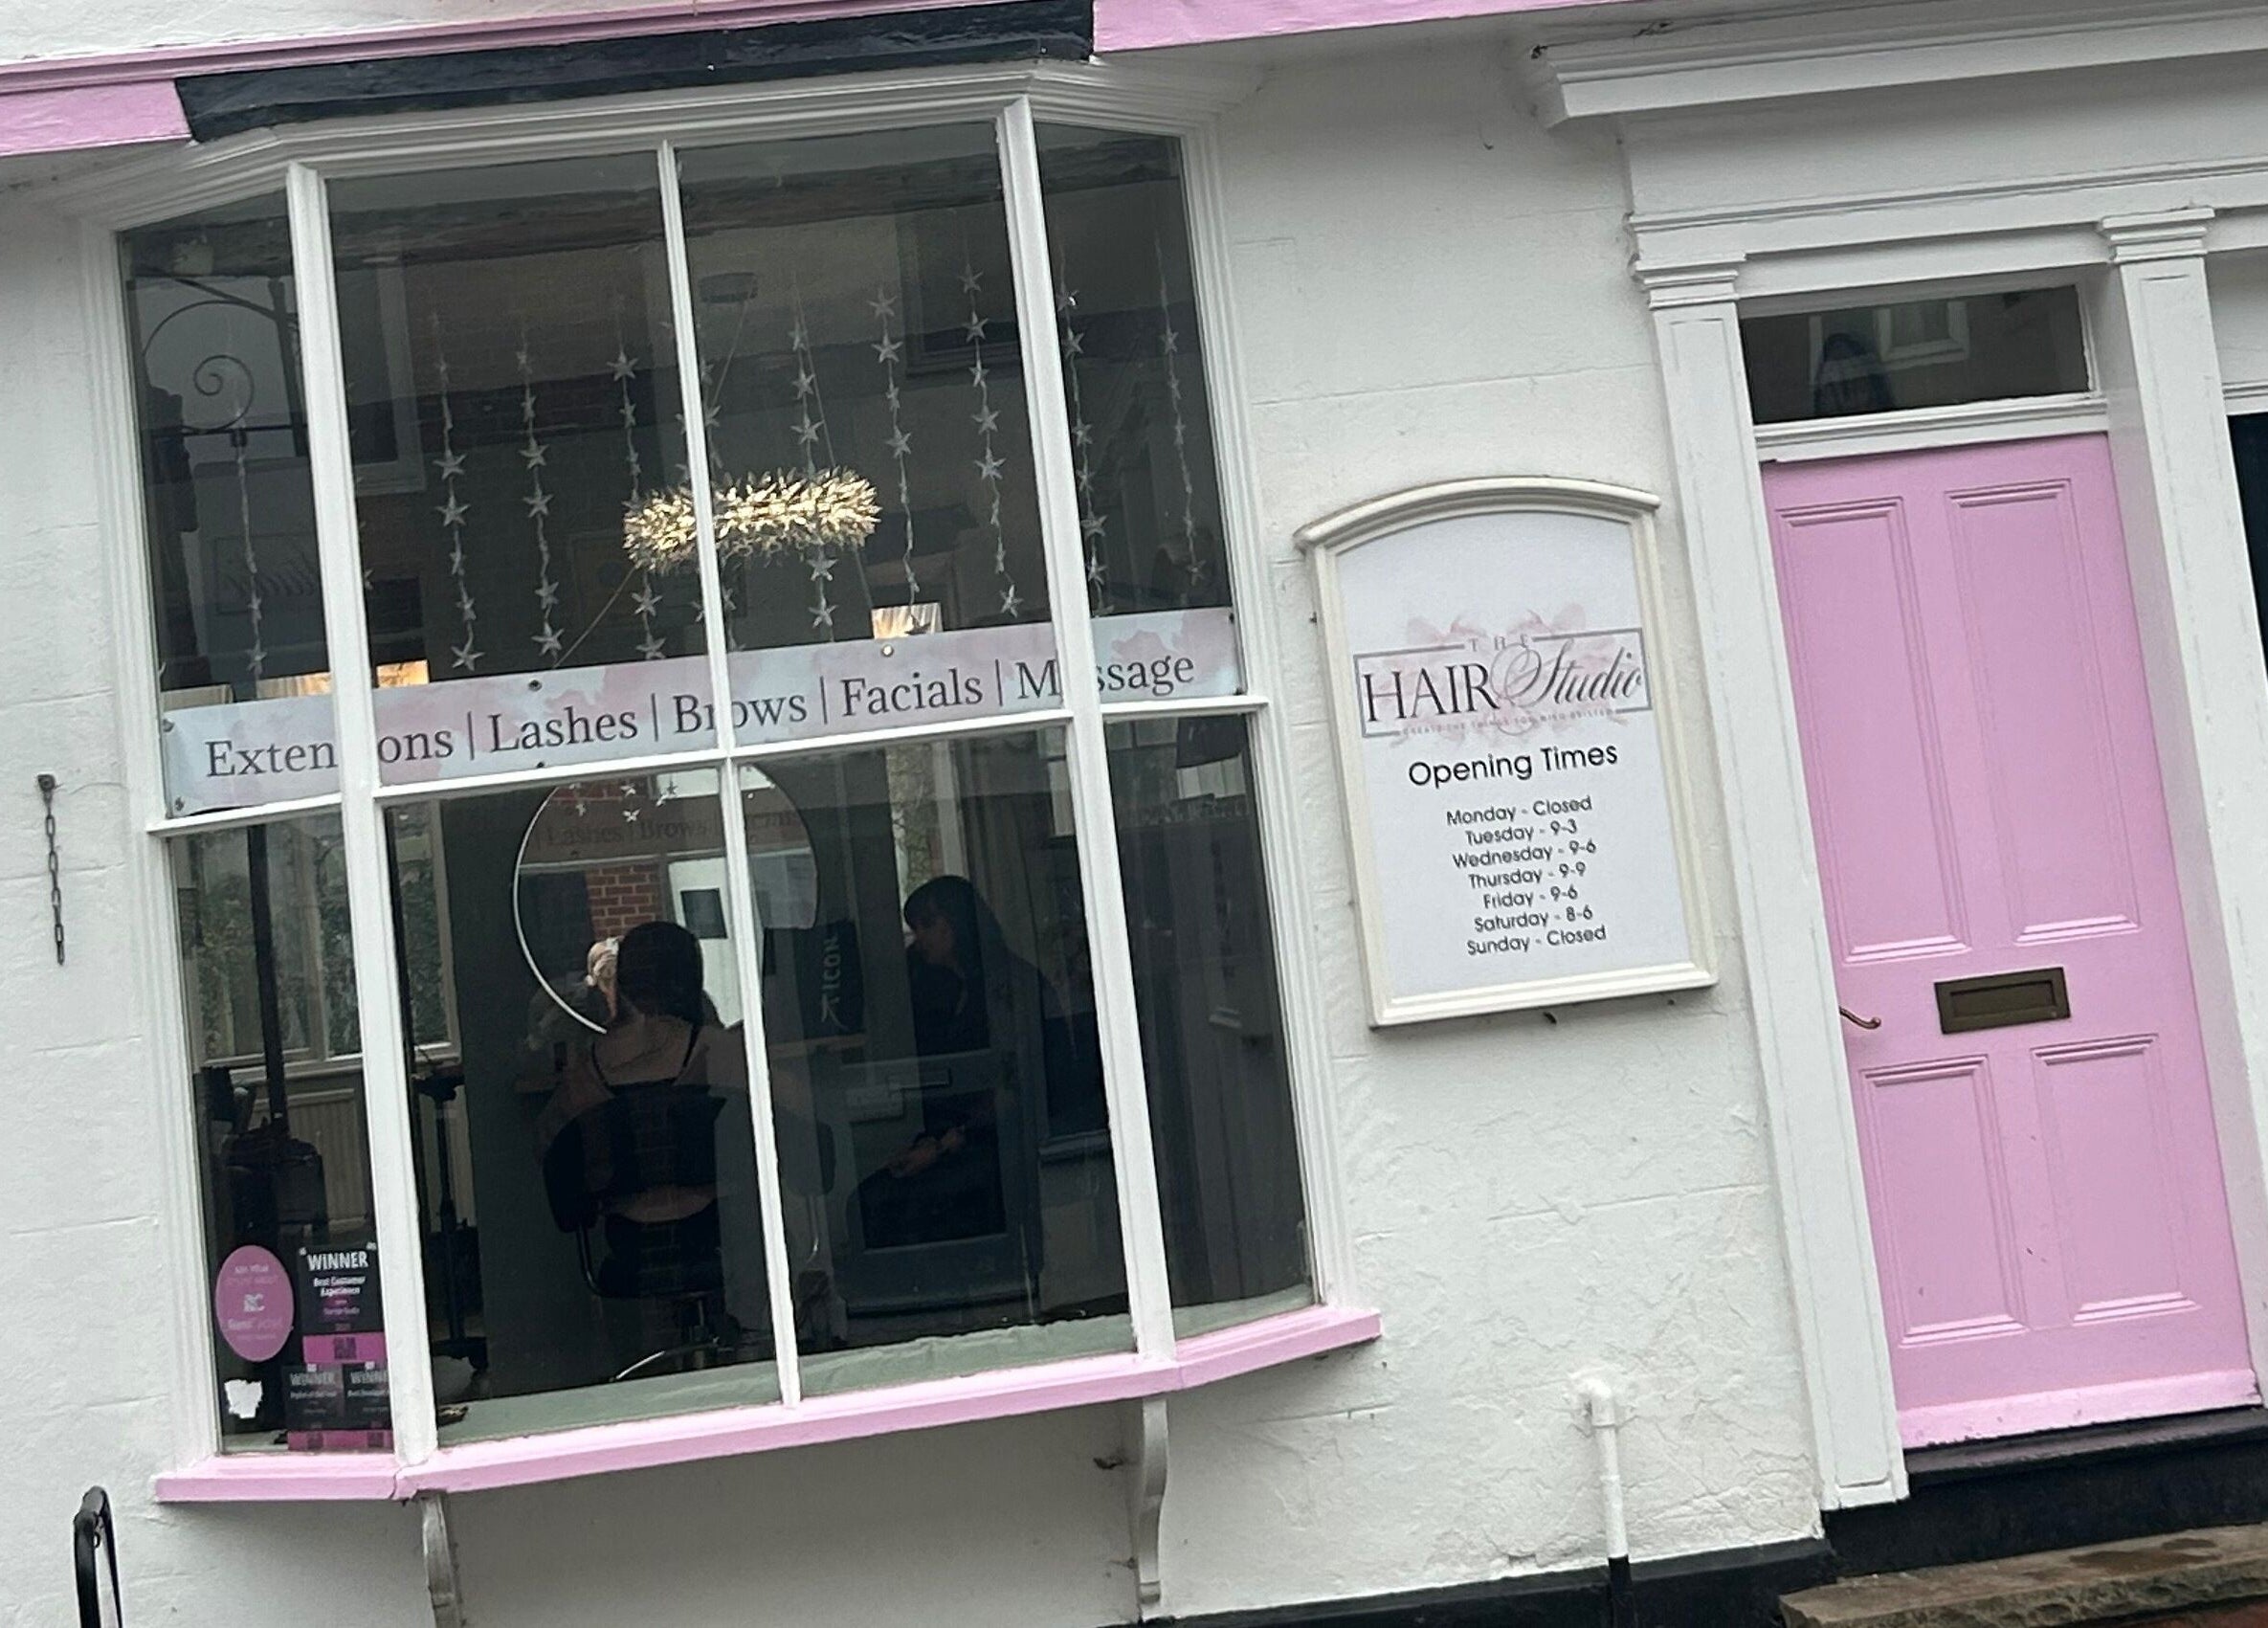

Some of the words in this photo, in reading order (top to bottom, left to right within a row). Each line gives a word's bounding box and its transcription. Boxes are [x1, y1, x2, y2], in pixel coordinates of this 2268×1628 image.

[1362, 661, 1501, 723] HAIR
[1489, 638, 1642, 733] Studio
[204, 728, 454, 777] Extenons
[487, 704, 638, 753] Lashes
[840, 666, 984, 717] Facials
[1014, 655, 1194, 699] Msage
[1408, 752, 1533, 789] Opening
[1540, 744, 1618, 771] Times
[1446, 804, 1517, 826] Monday
[1532, 794, 1592, 816] Closed
[1465, 825, 1534, 846] Tuesday
[1550, 818, 1577, 836] 9-3
[1452, 844, 1553, 869] Wednesday
[1568, 838, 1596, 855] 9-6
[1468, 868, 1543, 889] Thursday
[1559, 861, 1586, 878] 9-9
[1483, 891, 1533, 909] Friday
[1550, 884, 1578, 902] 9-6
[1474, 910, 1548, 933] Saturday
[1566, 904, 1593, 923] 8-6
[1466, 934, 1530, 956] Sunday
[1546, 925, 1607, 947] Closed
[306, 1250, 369, 1272] WINNER
